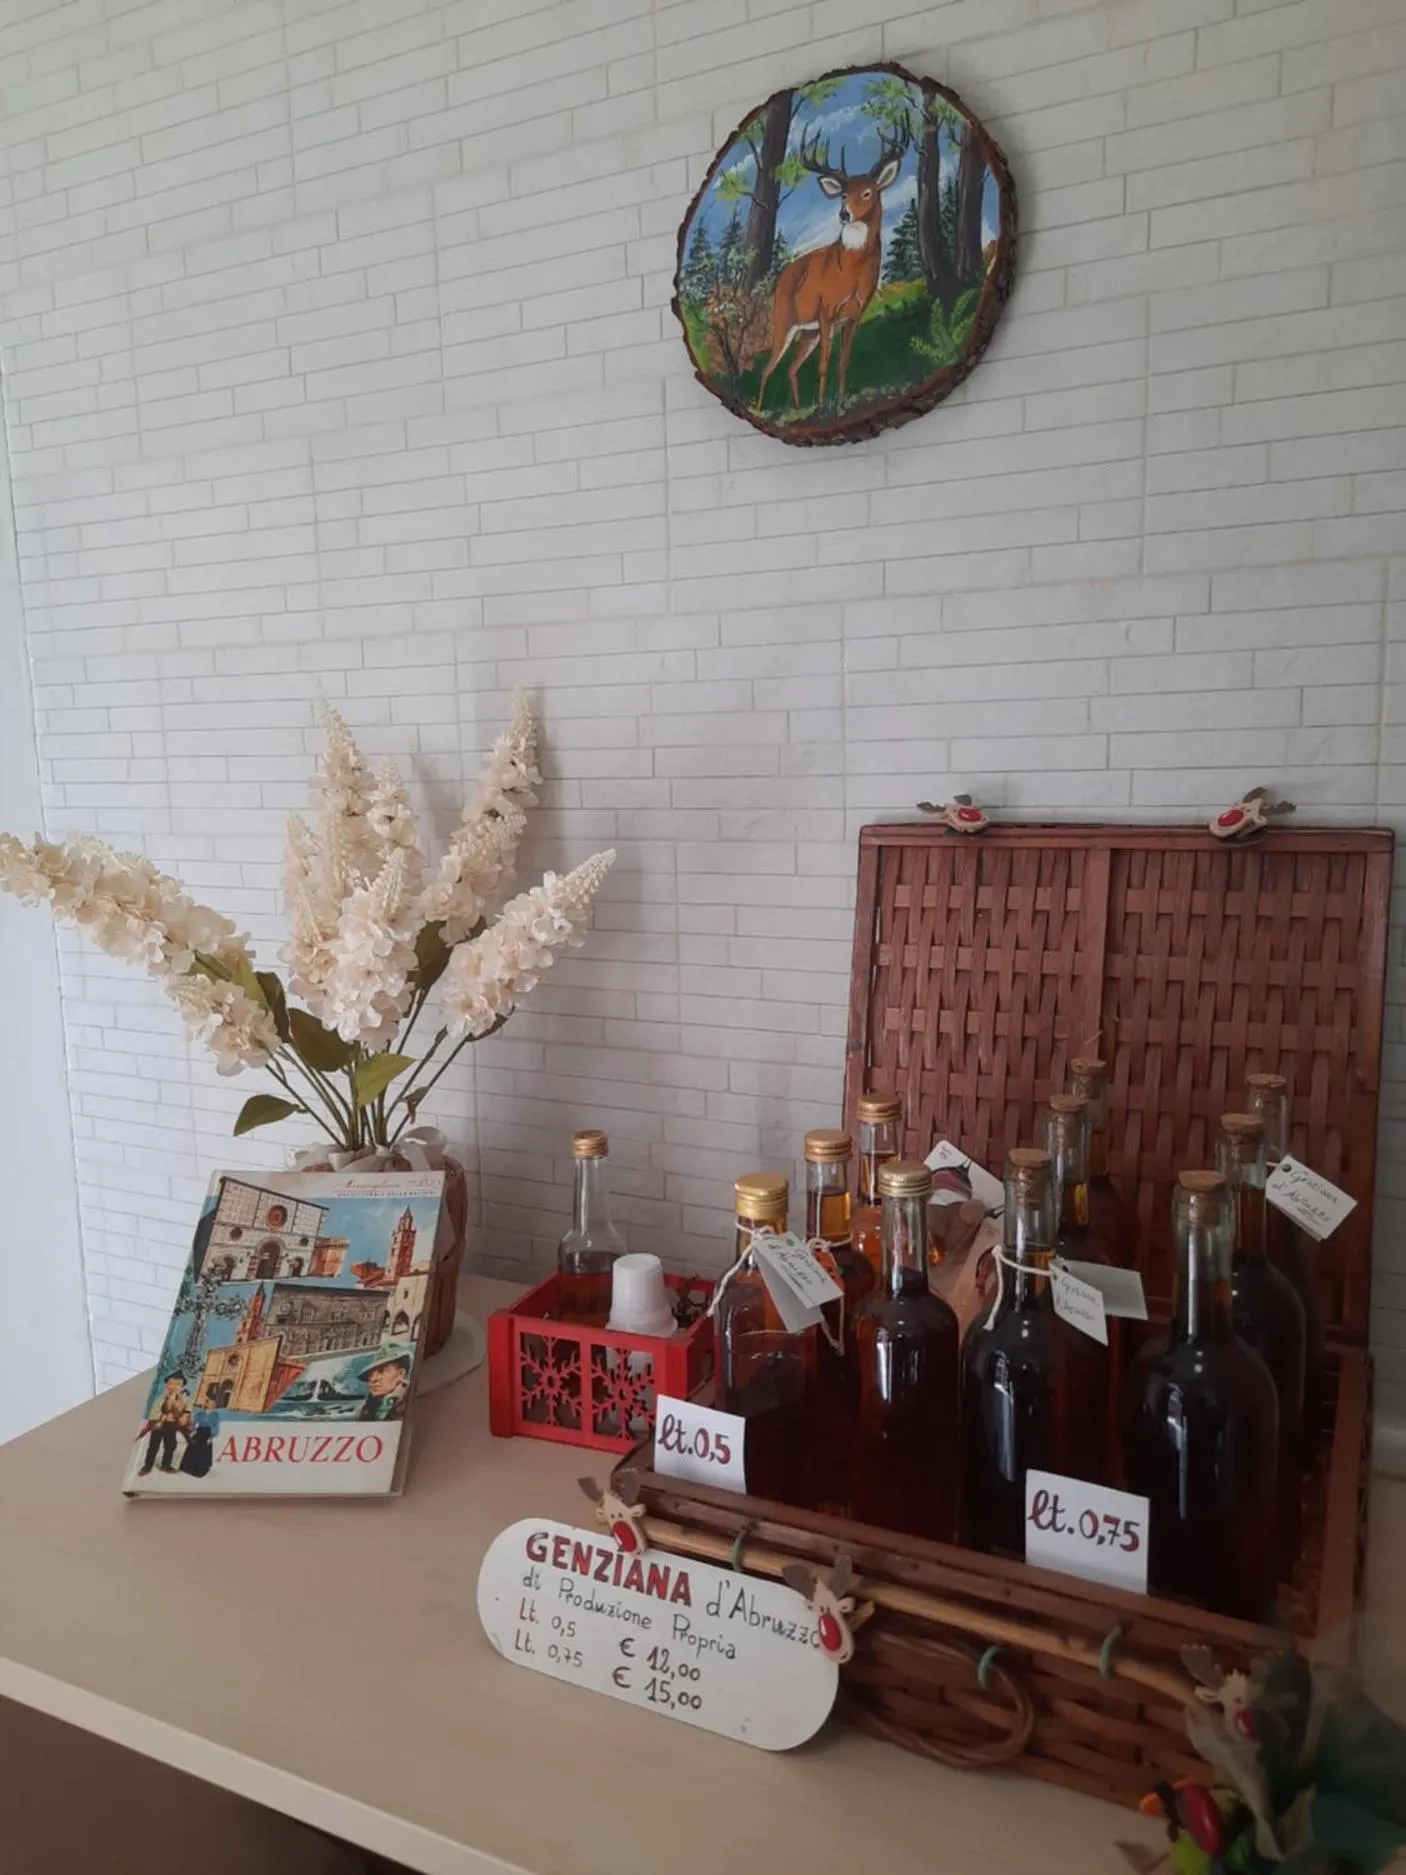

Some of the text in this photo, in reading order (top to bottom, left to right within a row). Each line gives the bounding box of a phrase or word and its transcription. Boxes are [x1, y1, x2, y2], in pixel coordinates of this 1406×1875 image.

[215, 1434, 383, 1463] ABRUZZO
[526, 1532, 692, 1607] GENZIANA
[519, 1597, 702, 1681] Lt. 0,5 € 12,00
[522, 1565, 736, 1659] di Produzione Propria
[514, 1629, 702, 1710] Lt. 0,75 € 15,00
